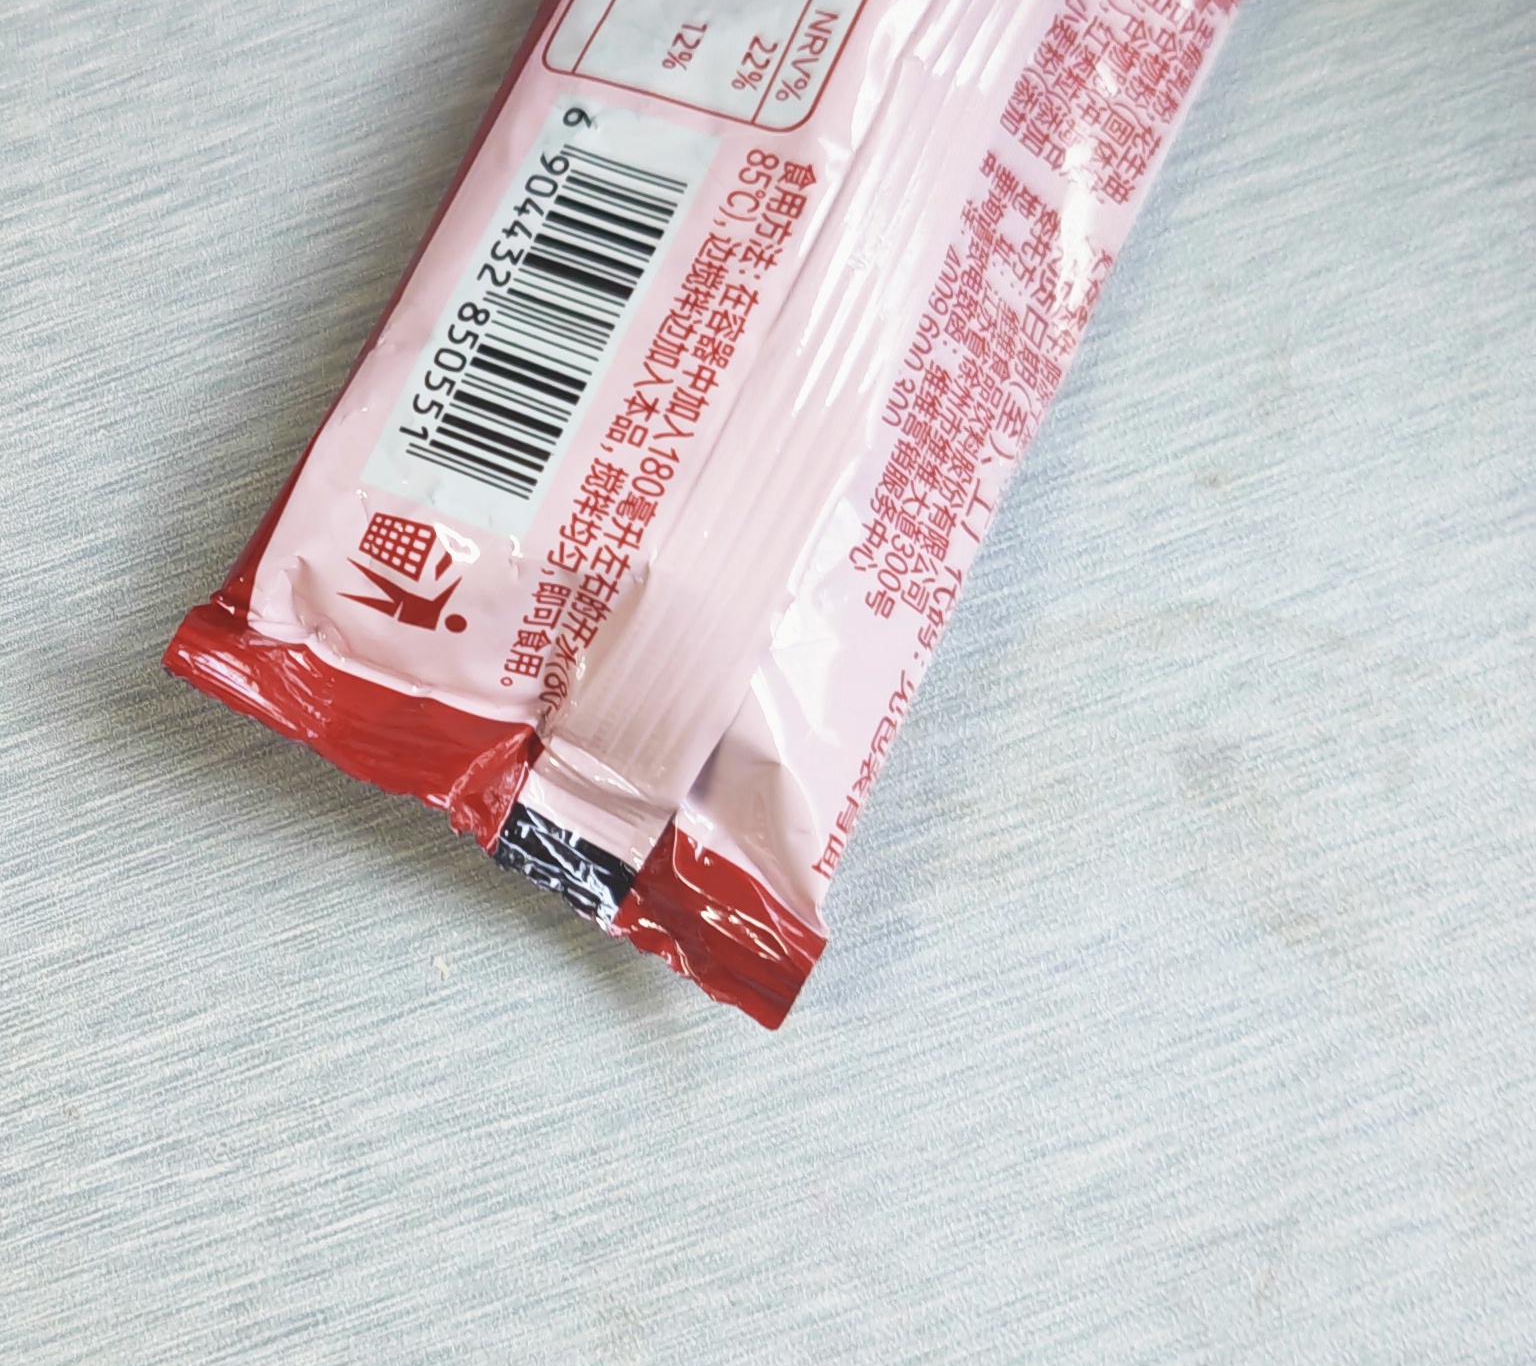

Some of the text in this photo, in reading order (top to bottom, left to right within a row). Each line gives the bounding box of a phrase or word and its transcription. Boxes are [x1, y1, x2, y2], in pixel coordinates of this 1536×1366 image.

[658, 12, 708, 77] 12%
[727, 31, 779, 97] 22%
[769, 3, 841, 109] NRV%
[395, 100, 596, 445] 6 904432 850551
